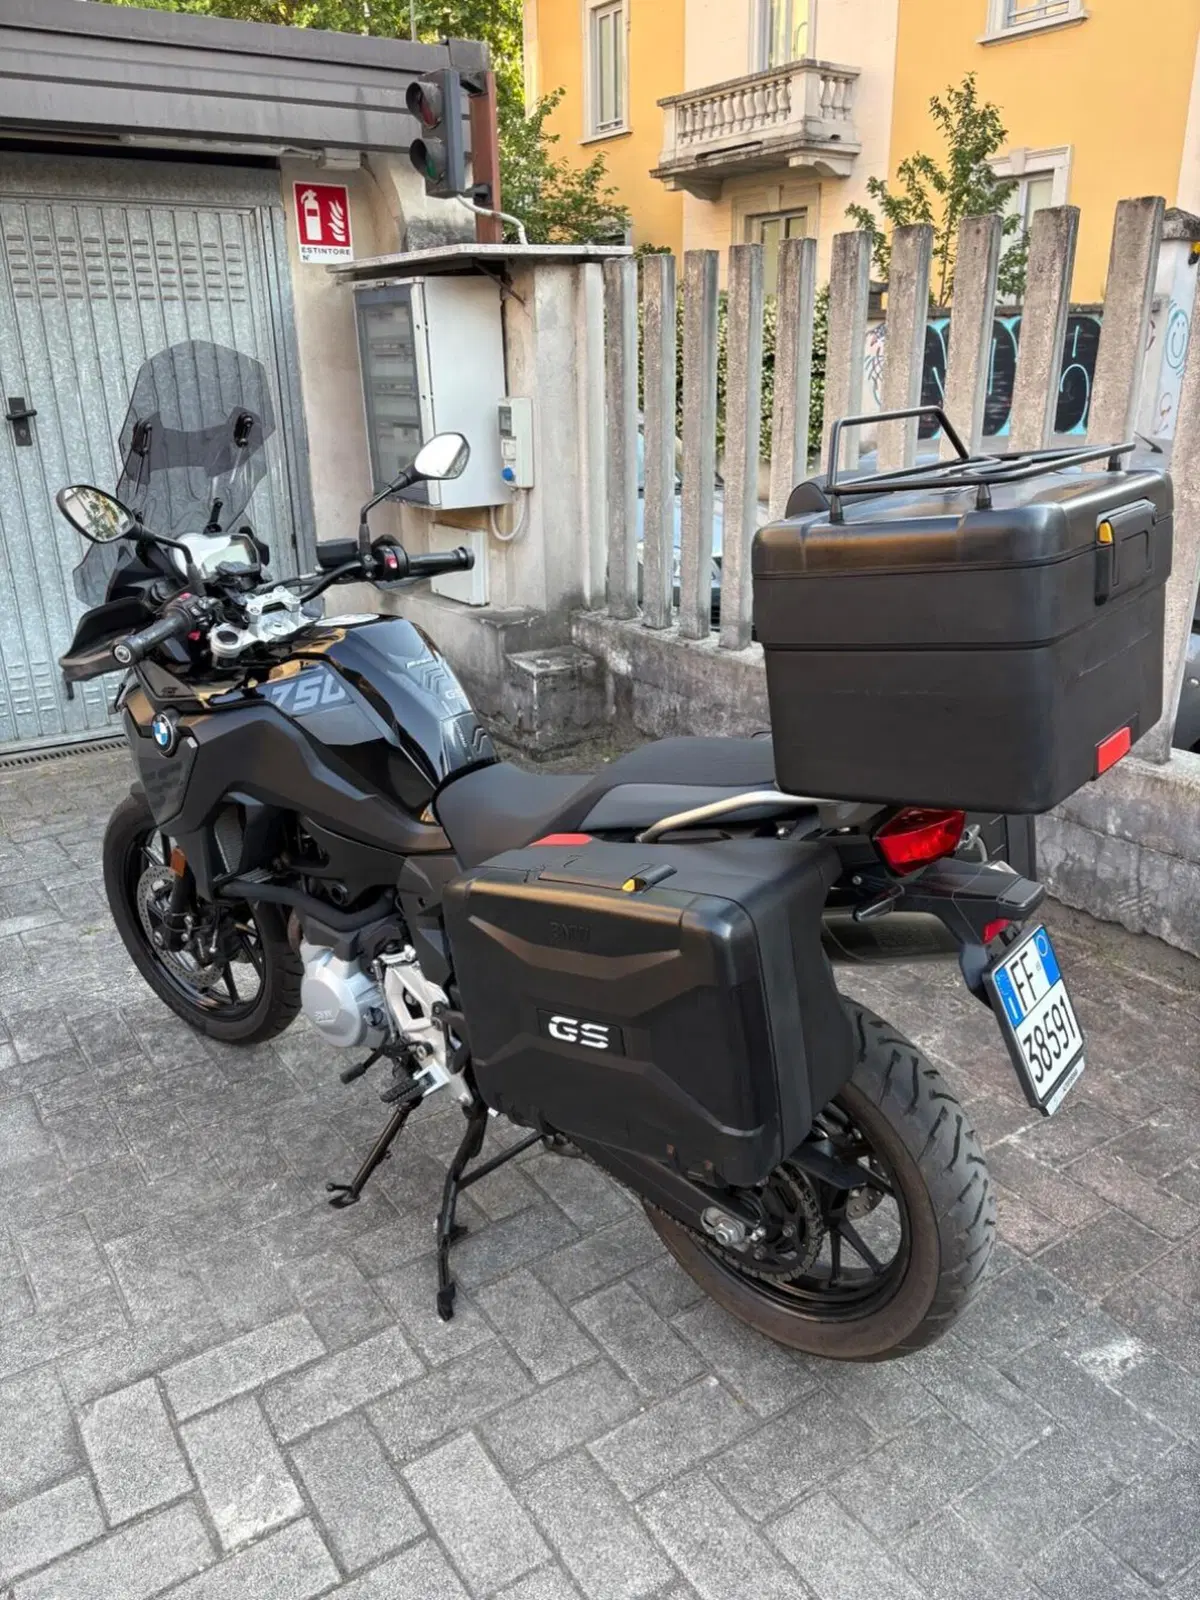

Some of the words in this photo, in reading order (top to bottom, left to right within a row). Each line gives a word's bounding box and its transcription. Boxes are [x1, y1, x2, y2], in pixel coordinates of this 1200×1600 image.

[301, 246, 351, 255] ESTINTORE
[1009, 950, 1038, 1012] FF
[547, 1015, 610, 1049] GS
[1022, 994, 1077, 1084] 38591
